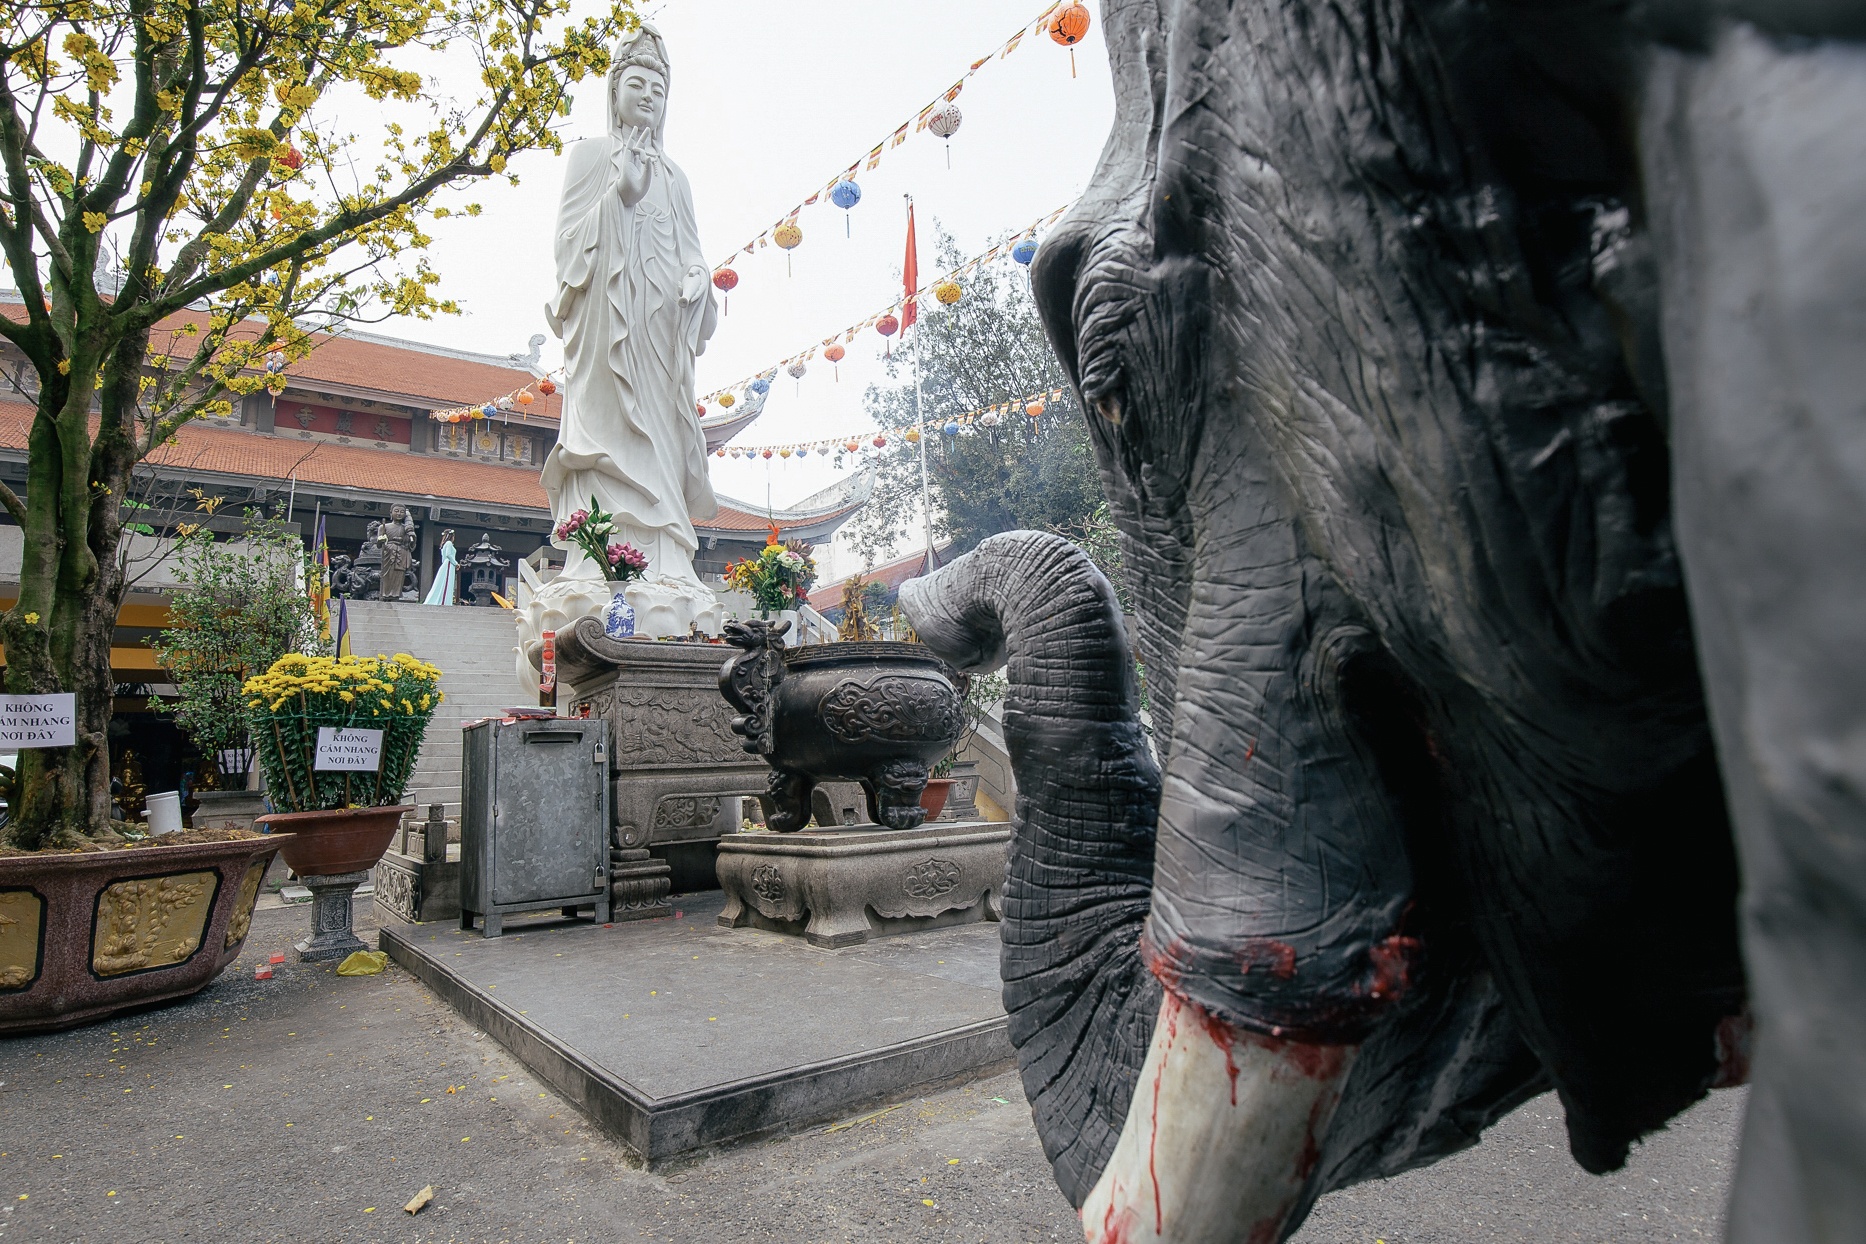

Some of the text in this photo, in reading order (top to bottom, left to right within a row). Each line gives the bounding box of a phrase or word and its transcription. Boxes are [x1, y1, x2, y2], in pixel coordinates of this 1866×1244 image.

[5, 702, 54, 713] KHÔNG
[21, 716, 70, 726] NHANG
[1, 729, 56, 740] NƠI ĐÂY
[332, 733, 369, 743] KHÔNG
[343, 746, 379, 755] NHANG
[328, 755, 368, 765] NƠI ĐÂY
